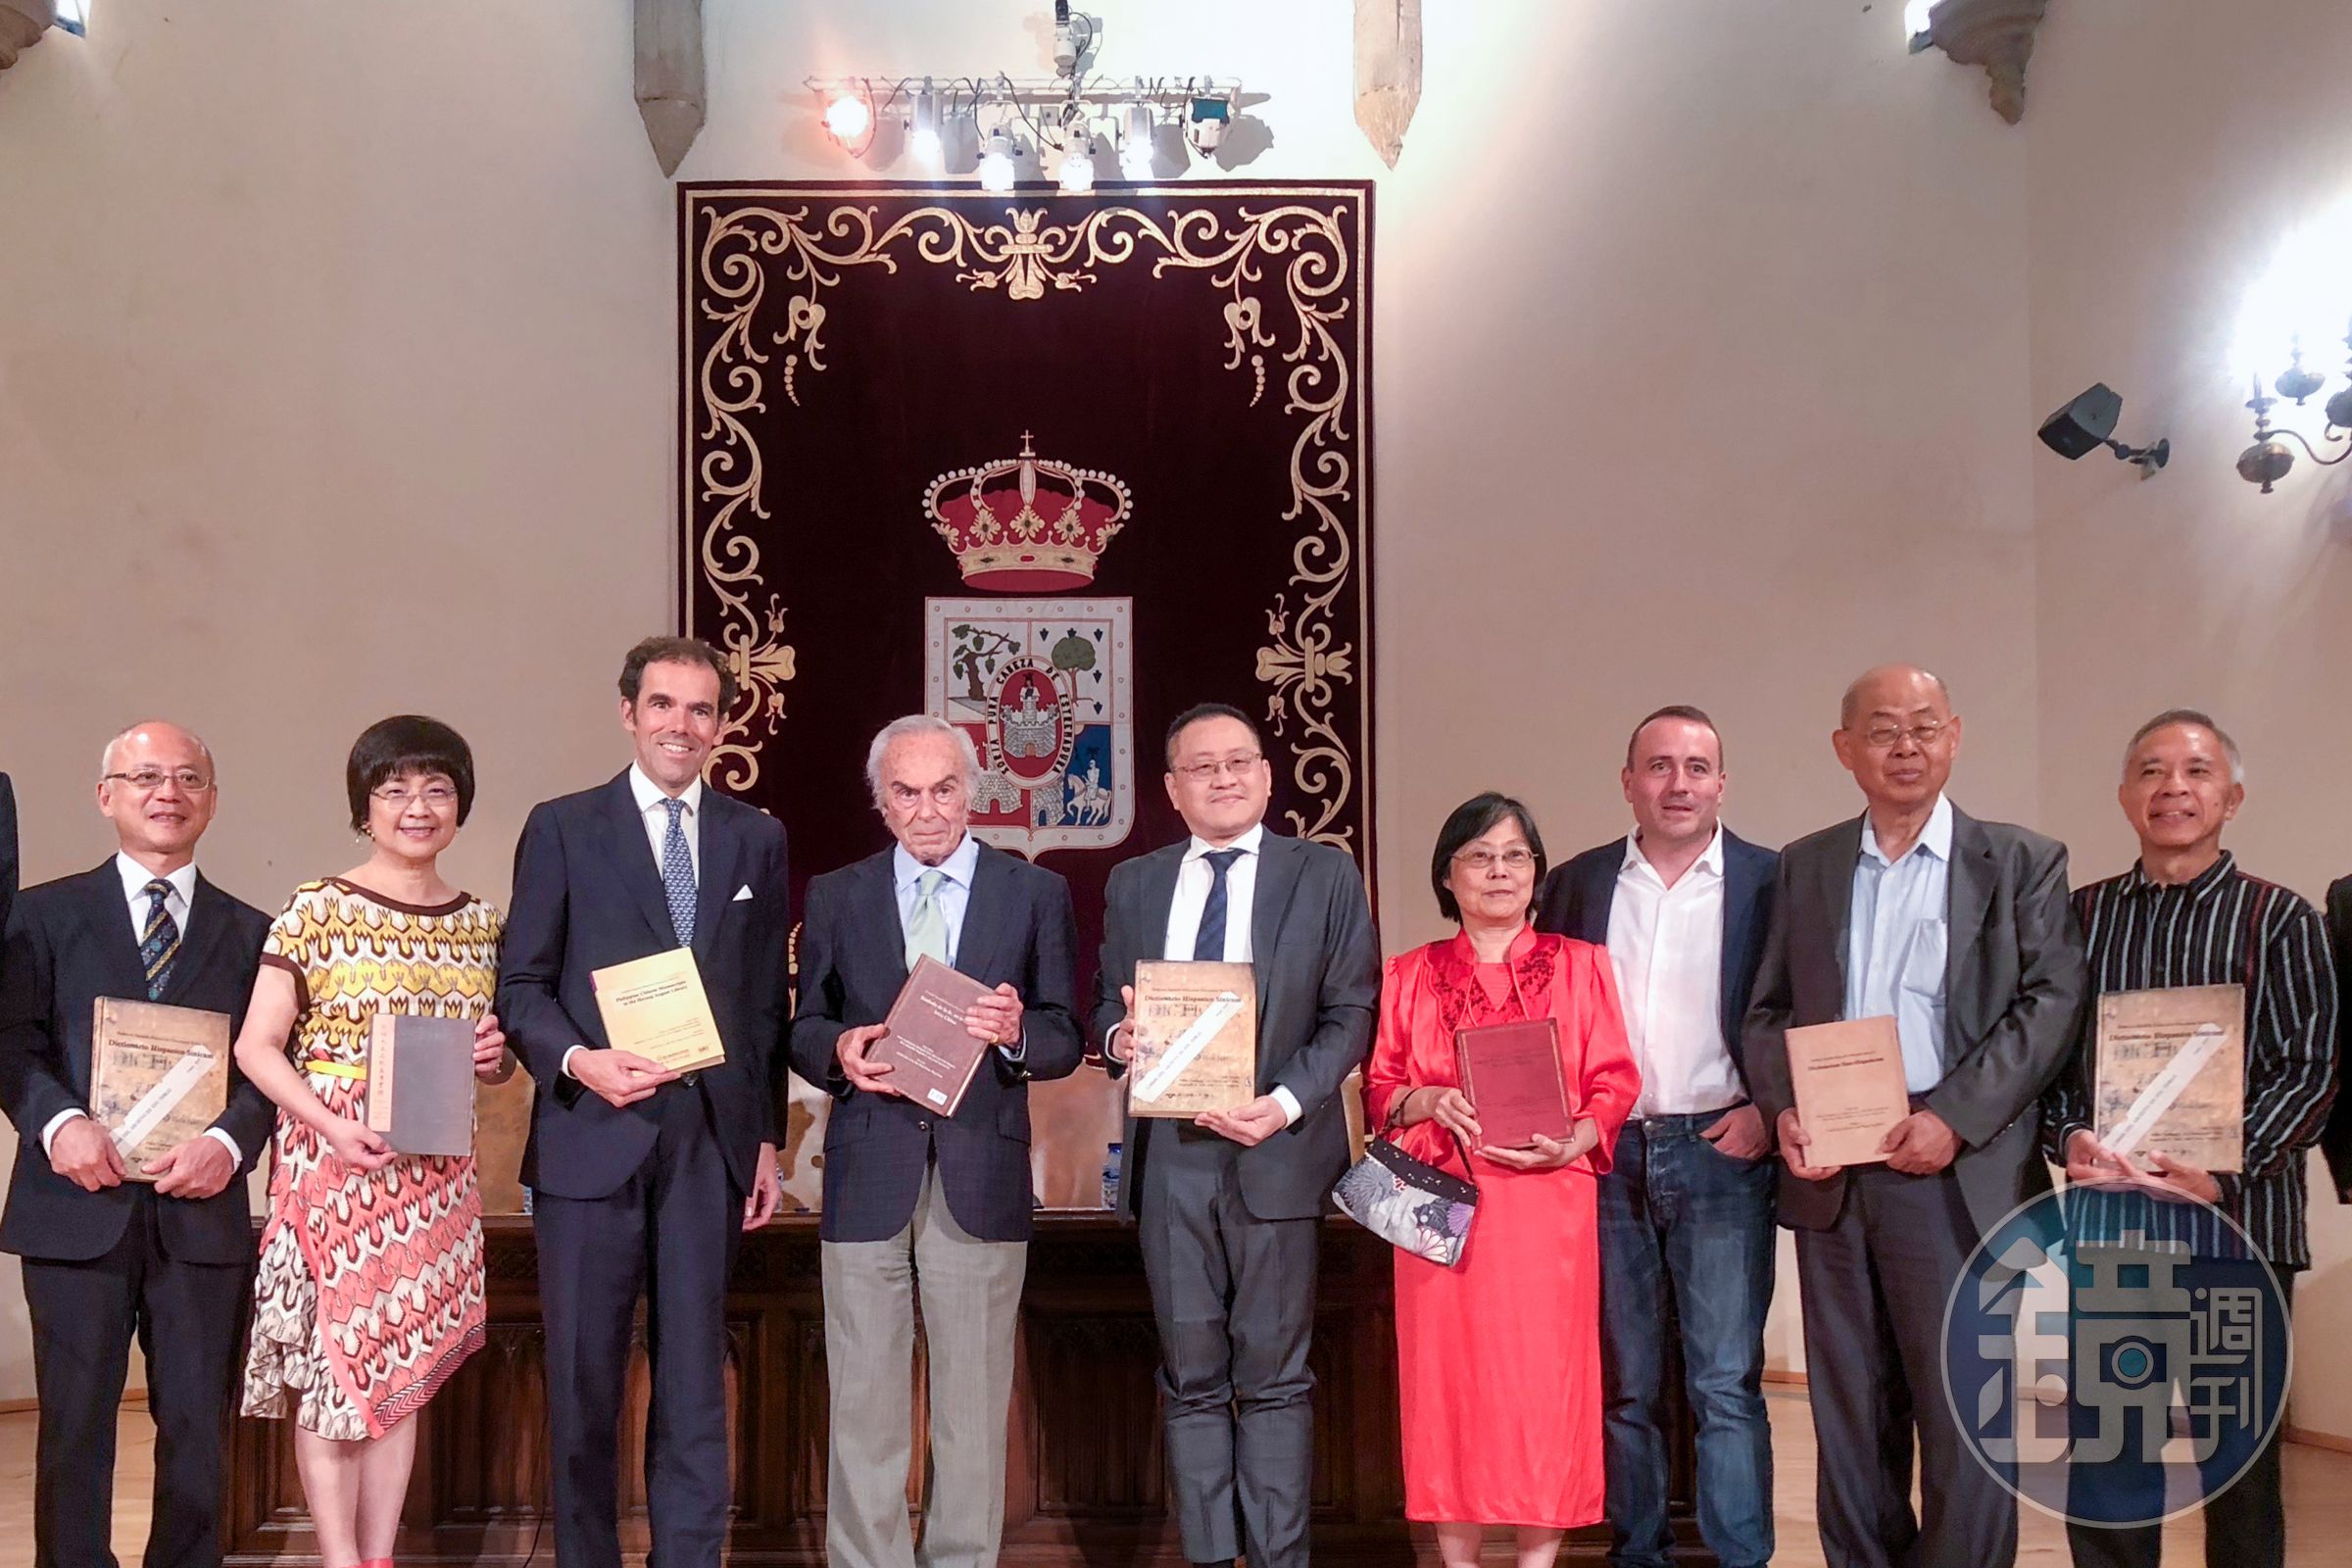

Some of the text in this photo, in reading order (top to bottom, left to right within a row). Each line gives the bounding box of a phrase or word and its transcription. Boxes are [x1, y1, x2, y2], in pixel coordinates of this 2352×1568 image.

[996, 659, 1034, 685] CABEZA
[1046, 666, 1060, 681] DE
[987, 696, 1000, 724] PURA
[990, 738, 1009, 775] SORIA
